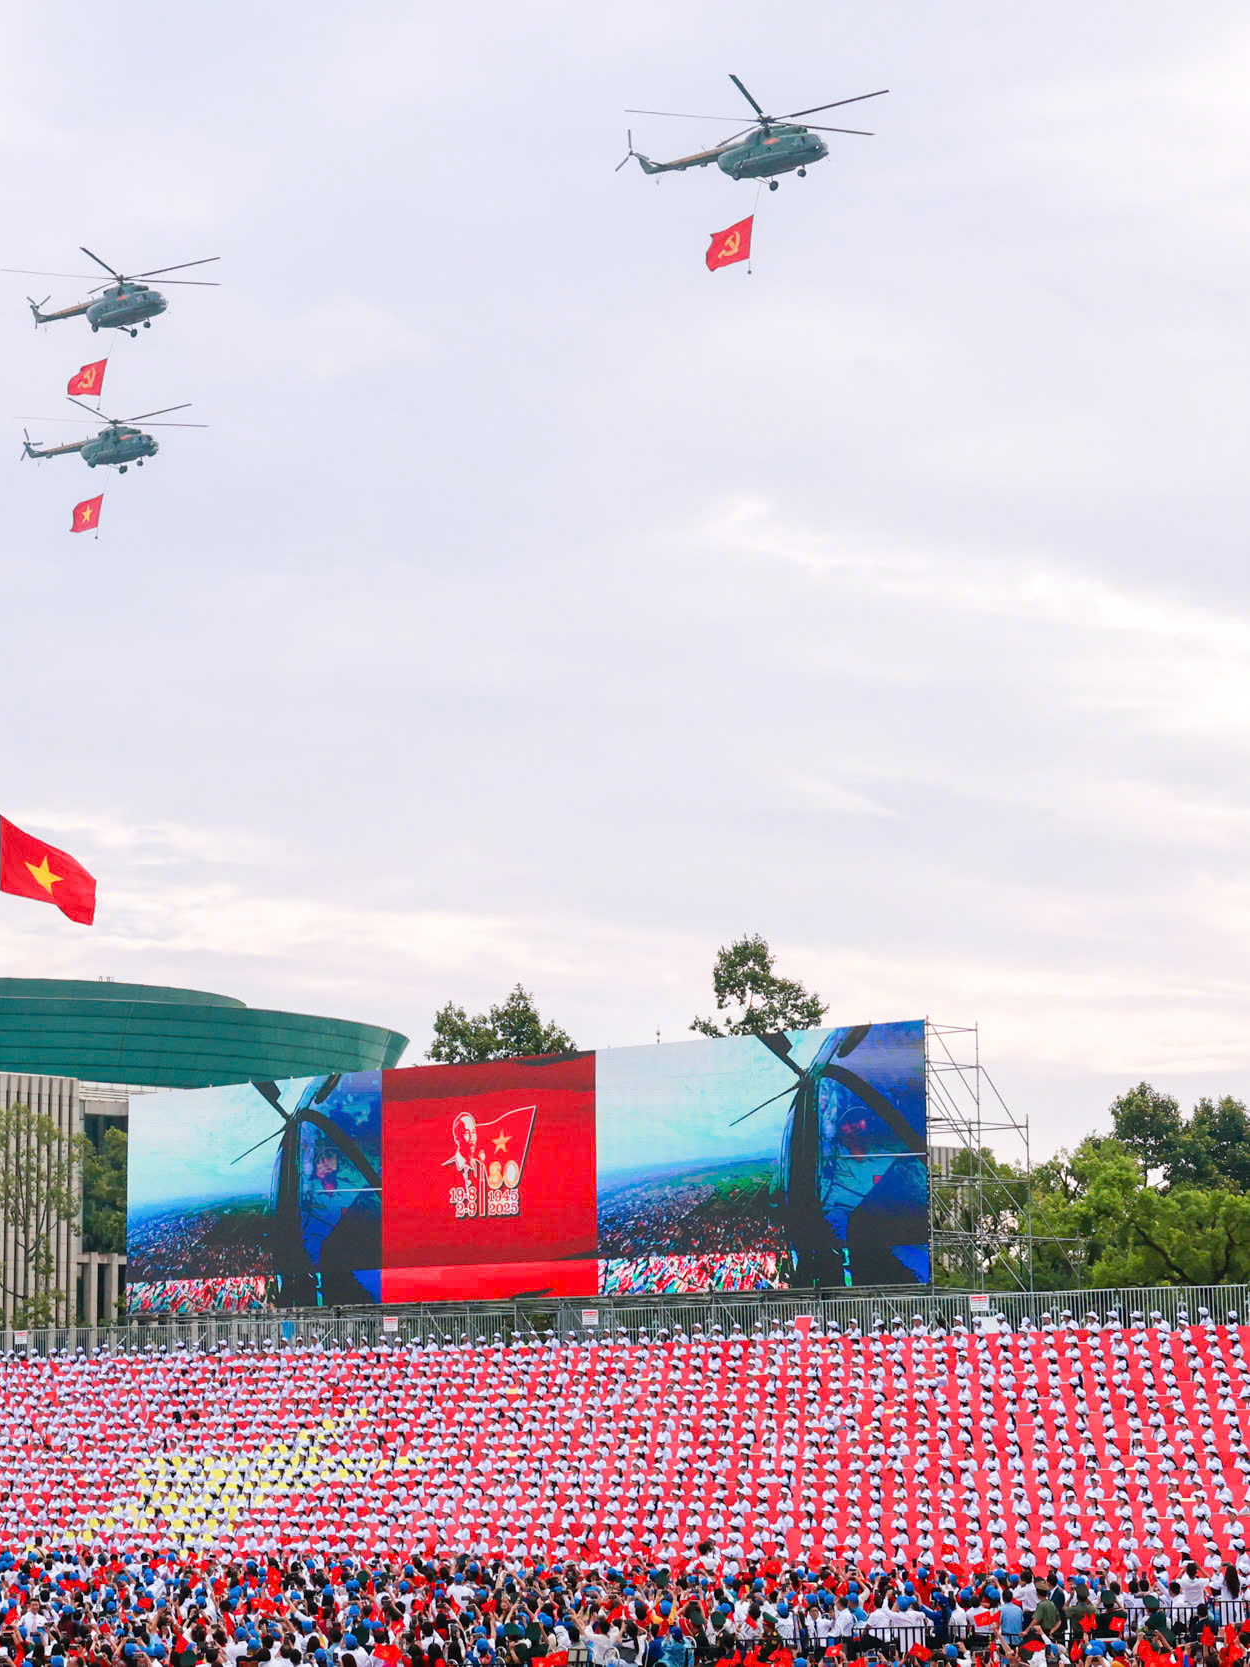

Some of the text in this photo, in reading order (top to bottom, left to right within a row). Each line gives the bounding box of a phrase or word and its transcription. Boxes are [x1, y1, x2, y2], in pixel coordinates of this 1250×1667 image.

[488, 1160, 519, 1189] 80
[488, 1189, 518, 1202] 1945
[488, 1202, 519, 1215] 2025
